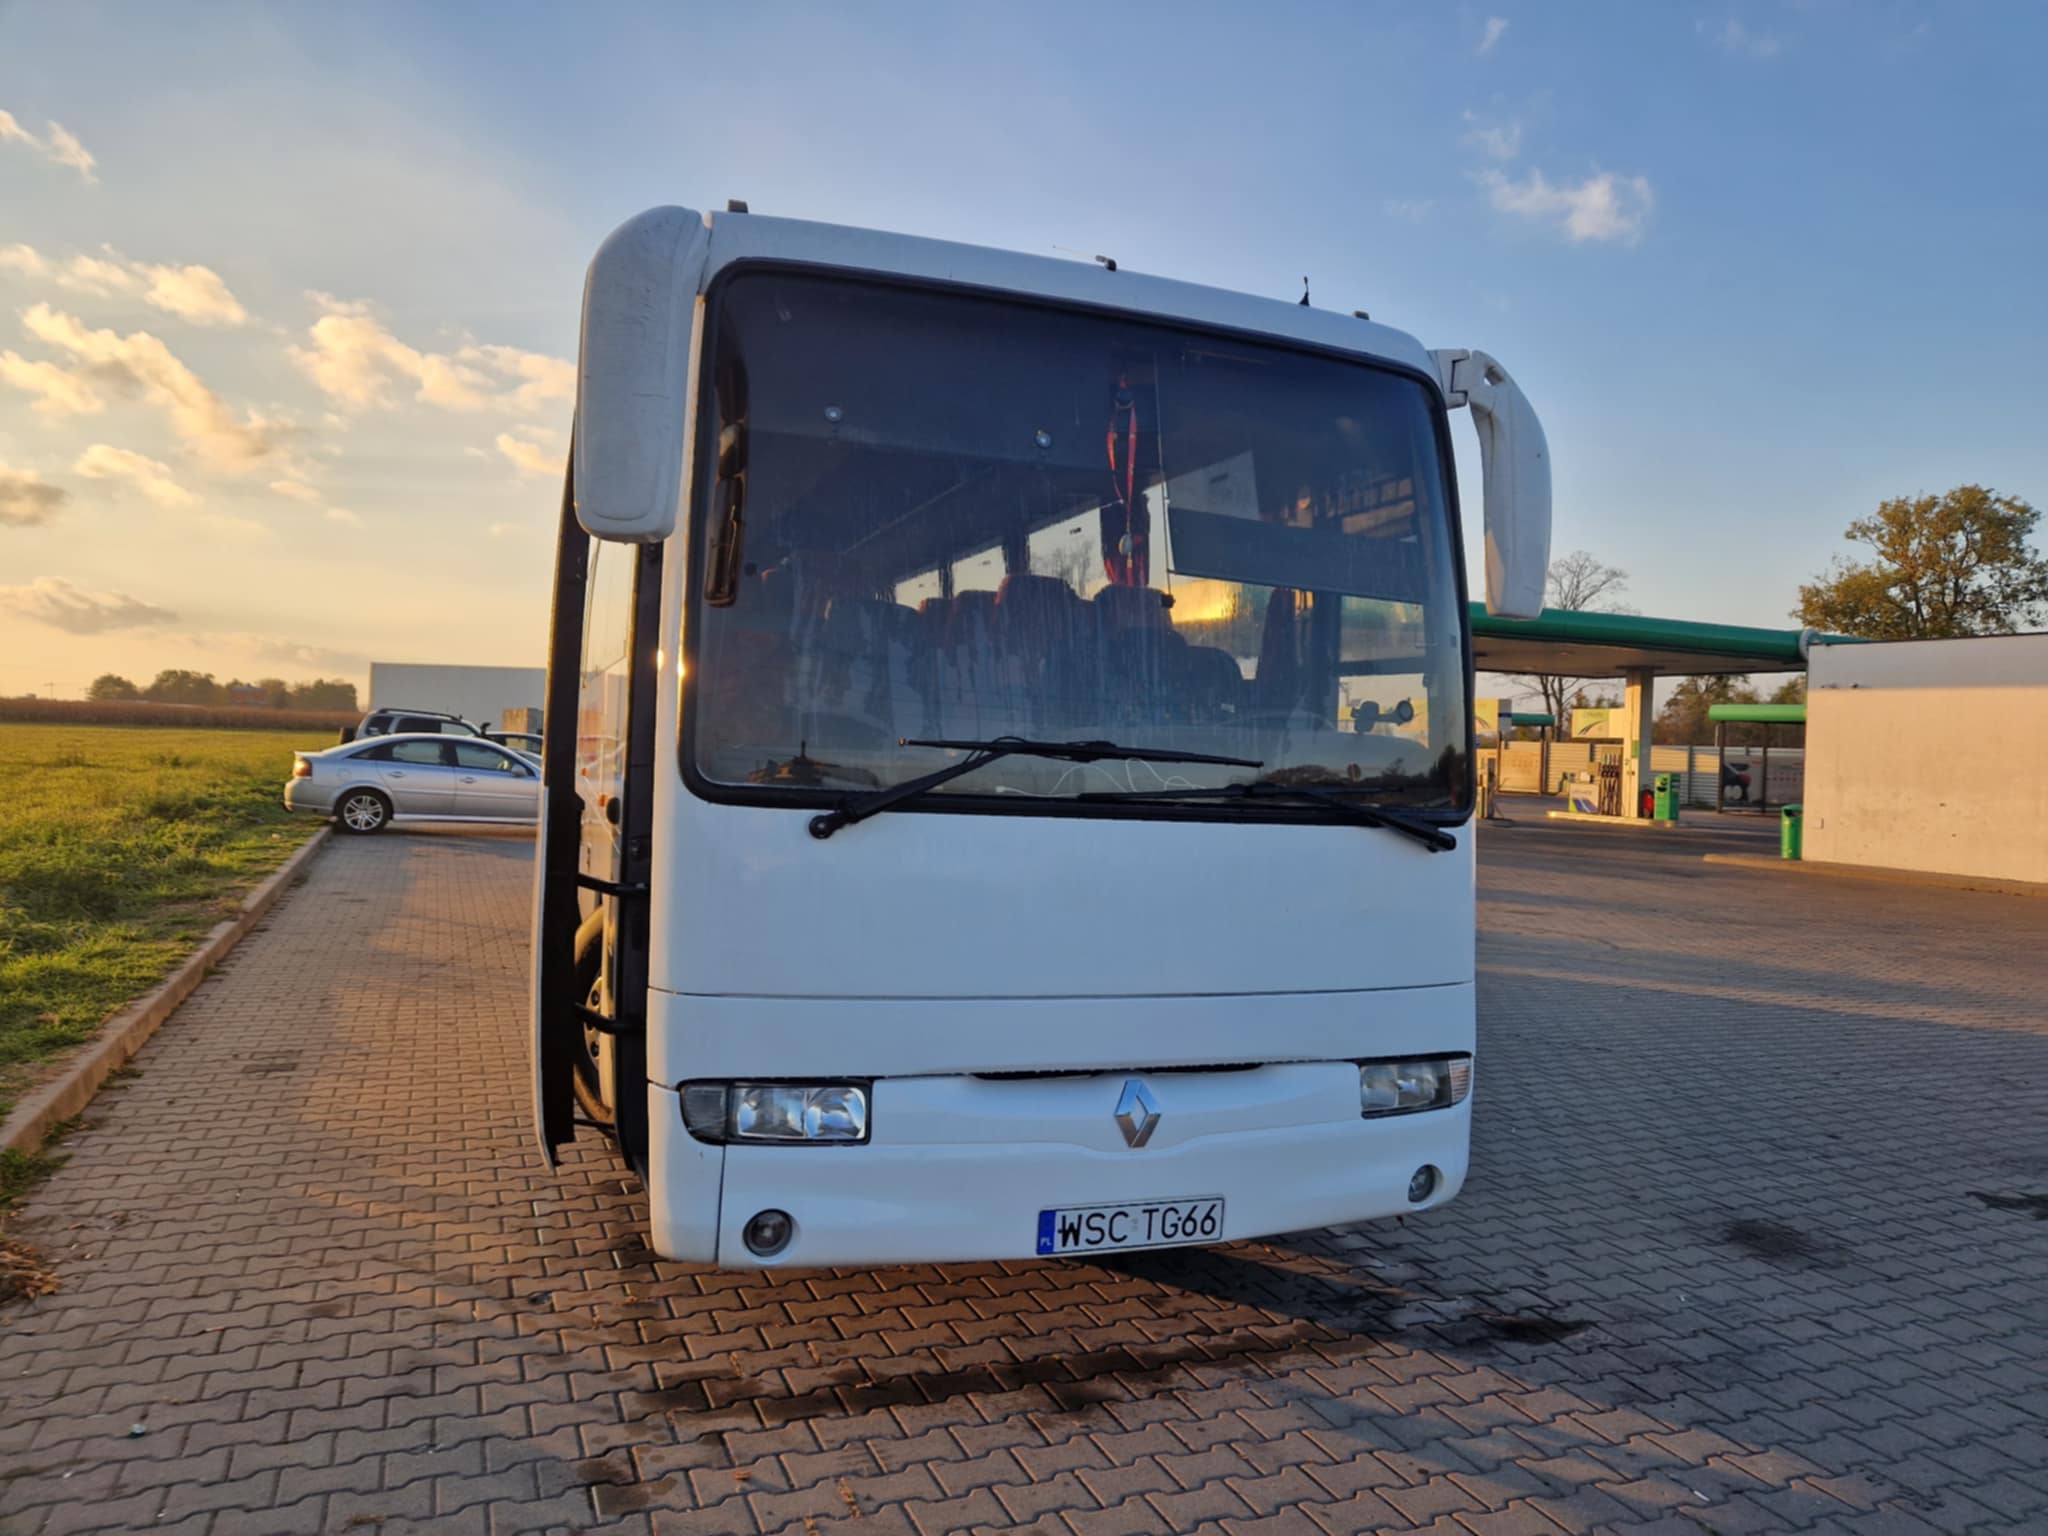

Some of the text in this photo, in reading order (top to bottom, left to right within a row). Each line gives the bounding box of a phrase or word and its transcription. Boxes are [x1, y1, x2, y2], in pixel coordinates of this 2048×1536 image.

[1061, 1203, 1217, 1248] WSC TG66
[1040, 1237, 1052, 1246] PL
